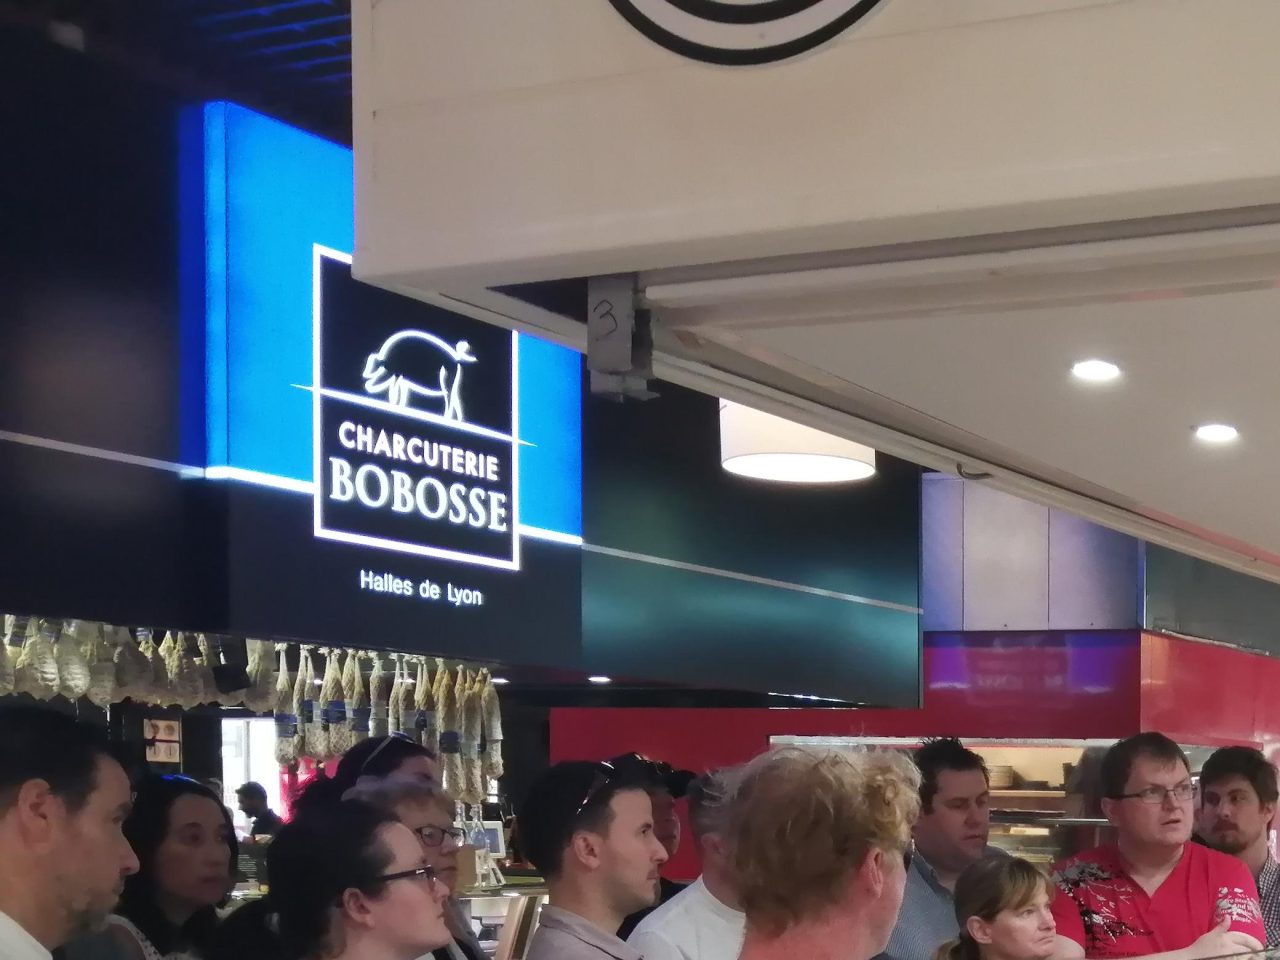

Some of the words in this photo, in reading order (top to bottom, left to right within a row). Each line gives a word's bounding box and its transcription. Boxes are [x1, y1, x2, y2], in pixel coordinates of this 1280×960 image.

[593, 299, 618, 336] 3
[338, 421, 499, 481] CHARCUTERIE
[329, 457, 508, 532] BOBOSSE
[360, 570, 413, 597] Halles
[419, 579, 440, 600] de
[447, 583, 483, 606] Lyon
